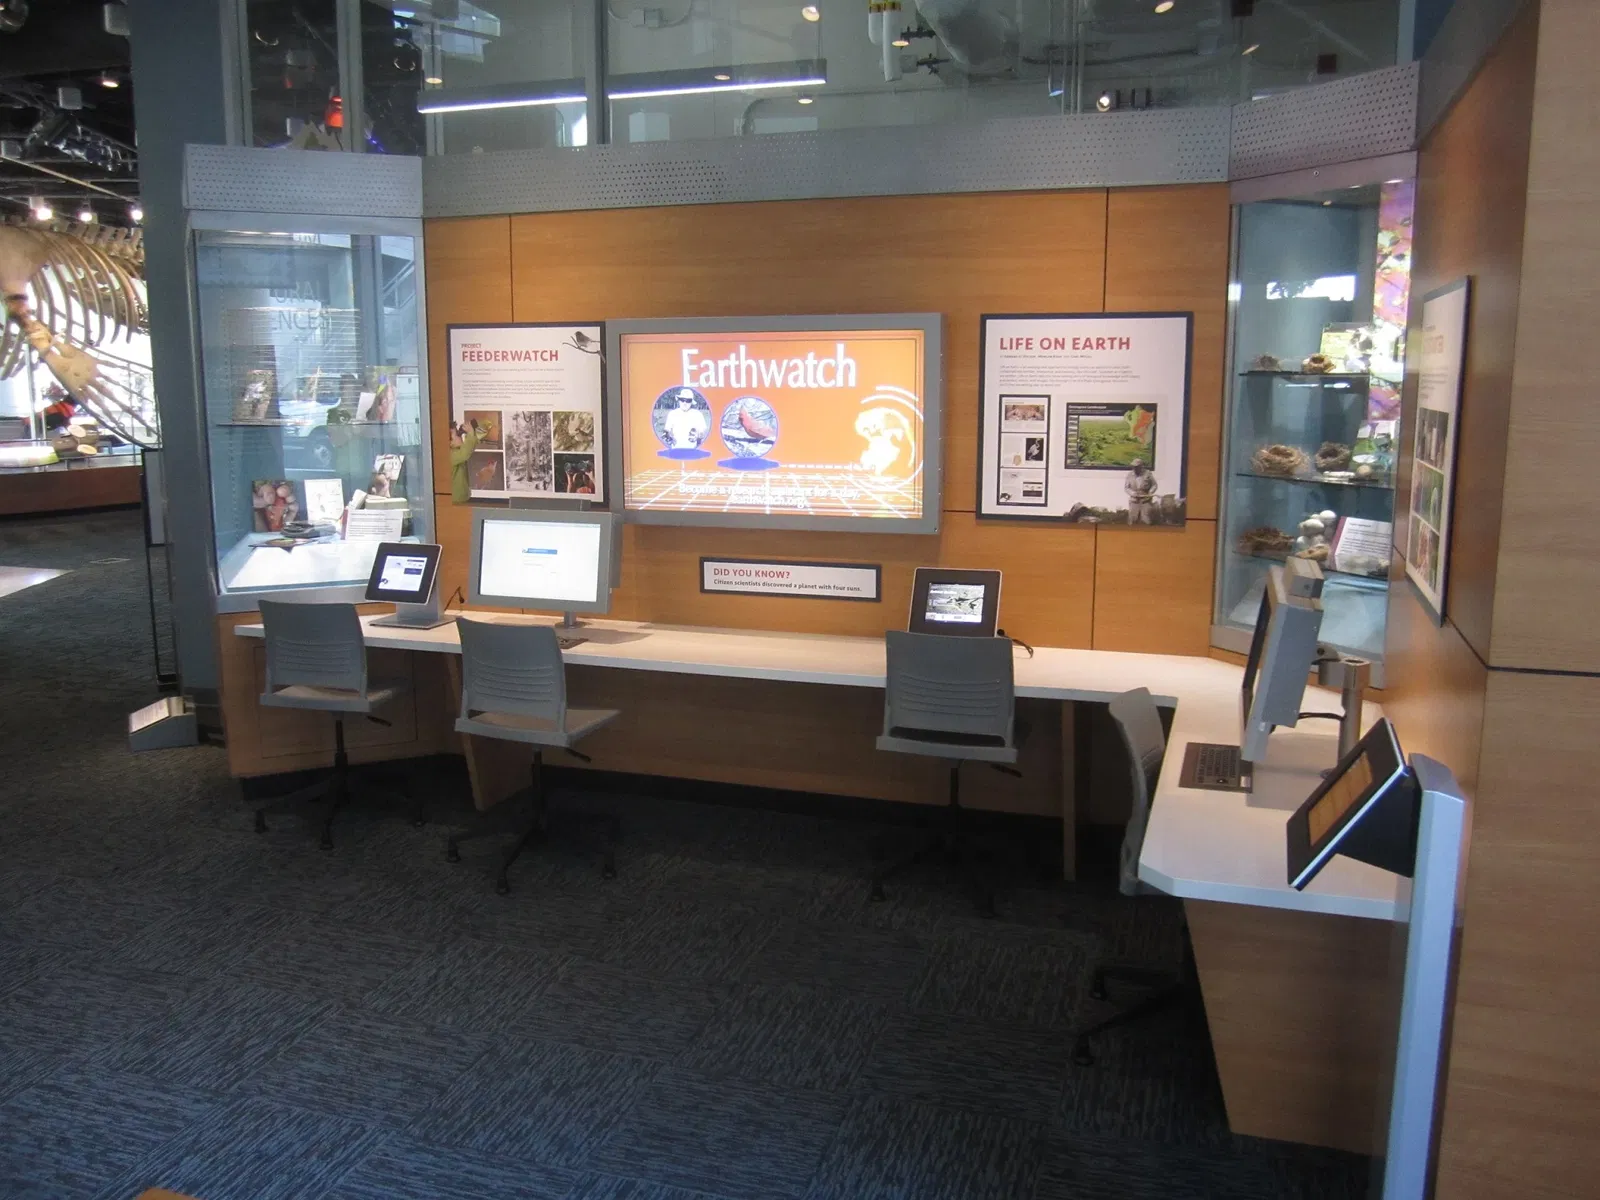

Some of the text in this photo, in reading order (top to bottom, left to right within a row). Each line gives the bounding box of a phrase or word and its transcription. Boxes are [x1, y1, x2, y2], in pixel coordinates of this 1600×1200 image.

[999, 336, 1131, 351] LIFE ON EARTH
[462, 350, 559, 362] FEEDERWATCH
[681, 344, 857, 389] Earthwatch
[713, 567, 791, 579] DID YOU KNOW?
[762, 580, 793, 588] discovered
[798, 582, 818, 590] planet
